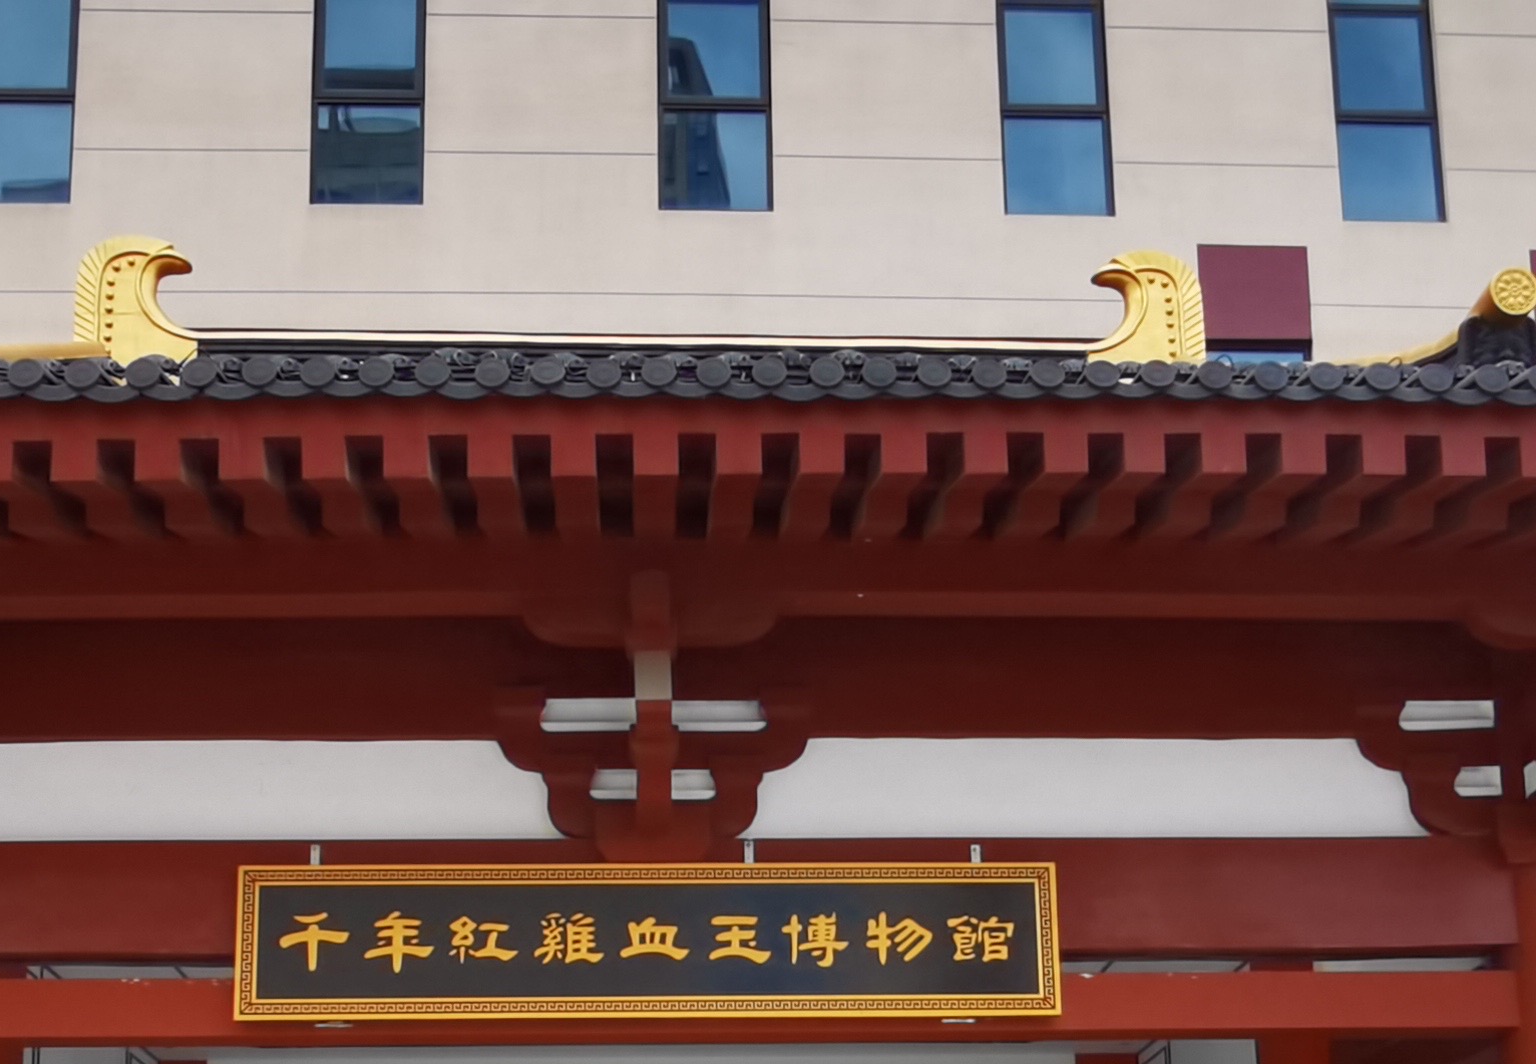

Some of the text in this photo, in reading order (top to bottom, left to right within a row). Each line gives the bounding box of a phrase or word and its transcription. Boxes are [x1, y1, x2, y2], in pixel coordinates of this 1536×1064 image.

[278, 910, 1016, 974] 千年紅雞血玉博物館
